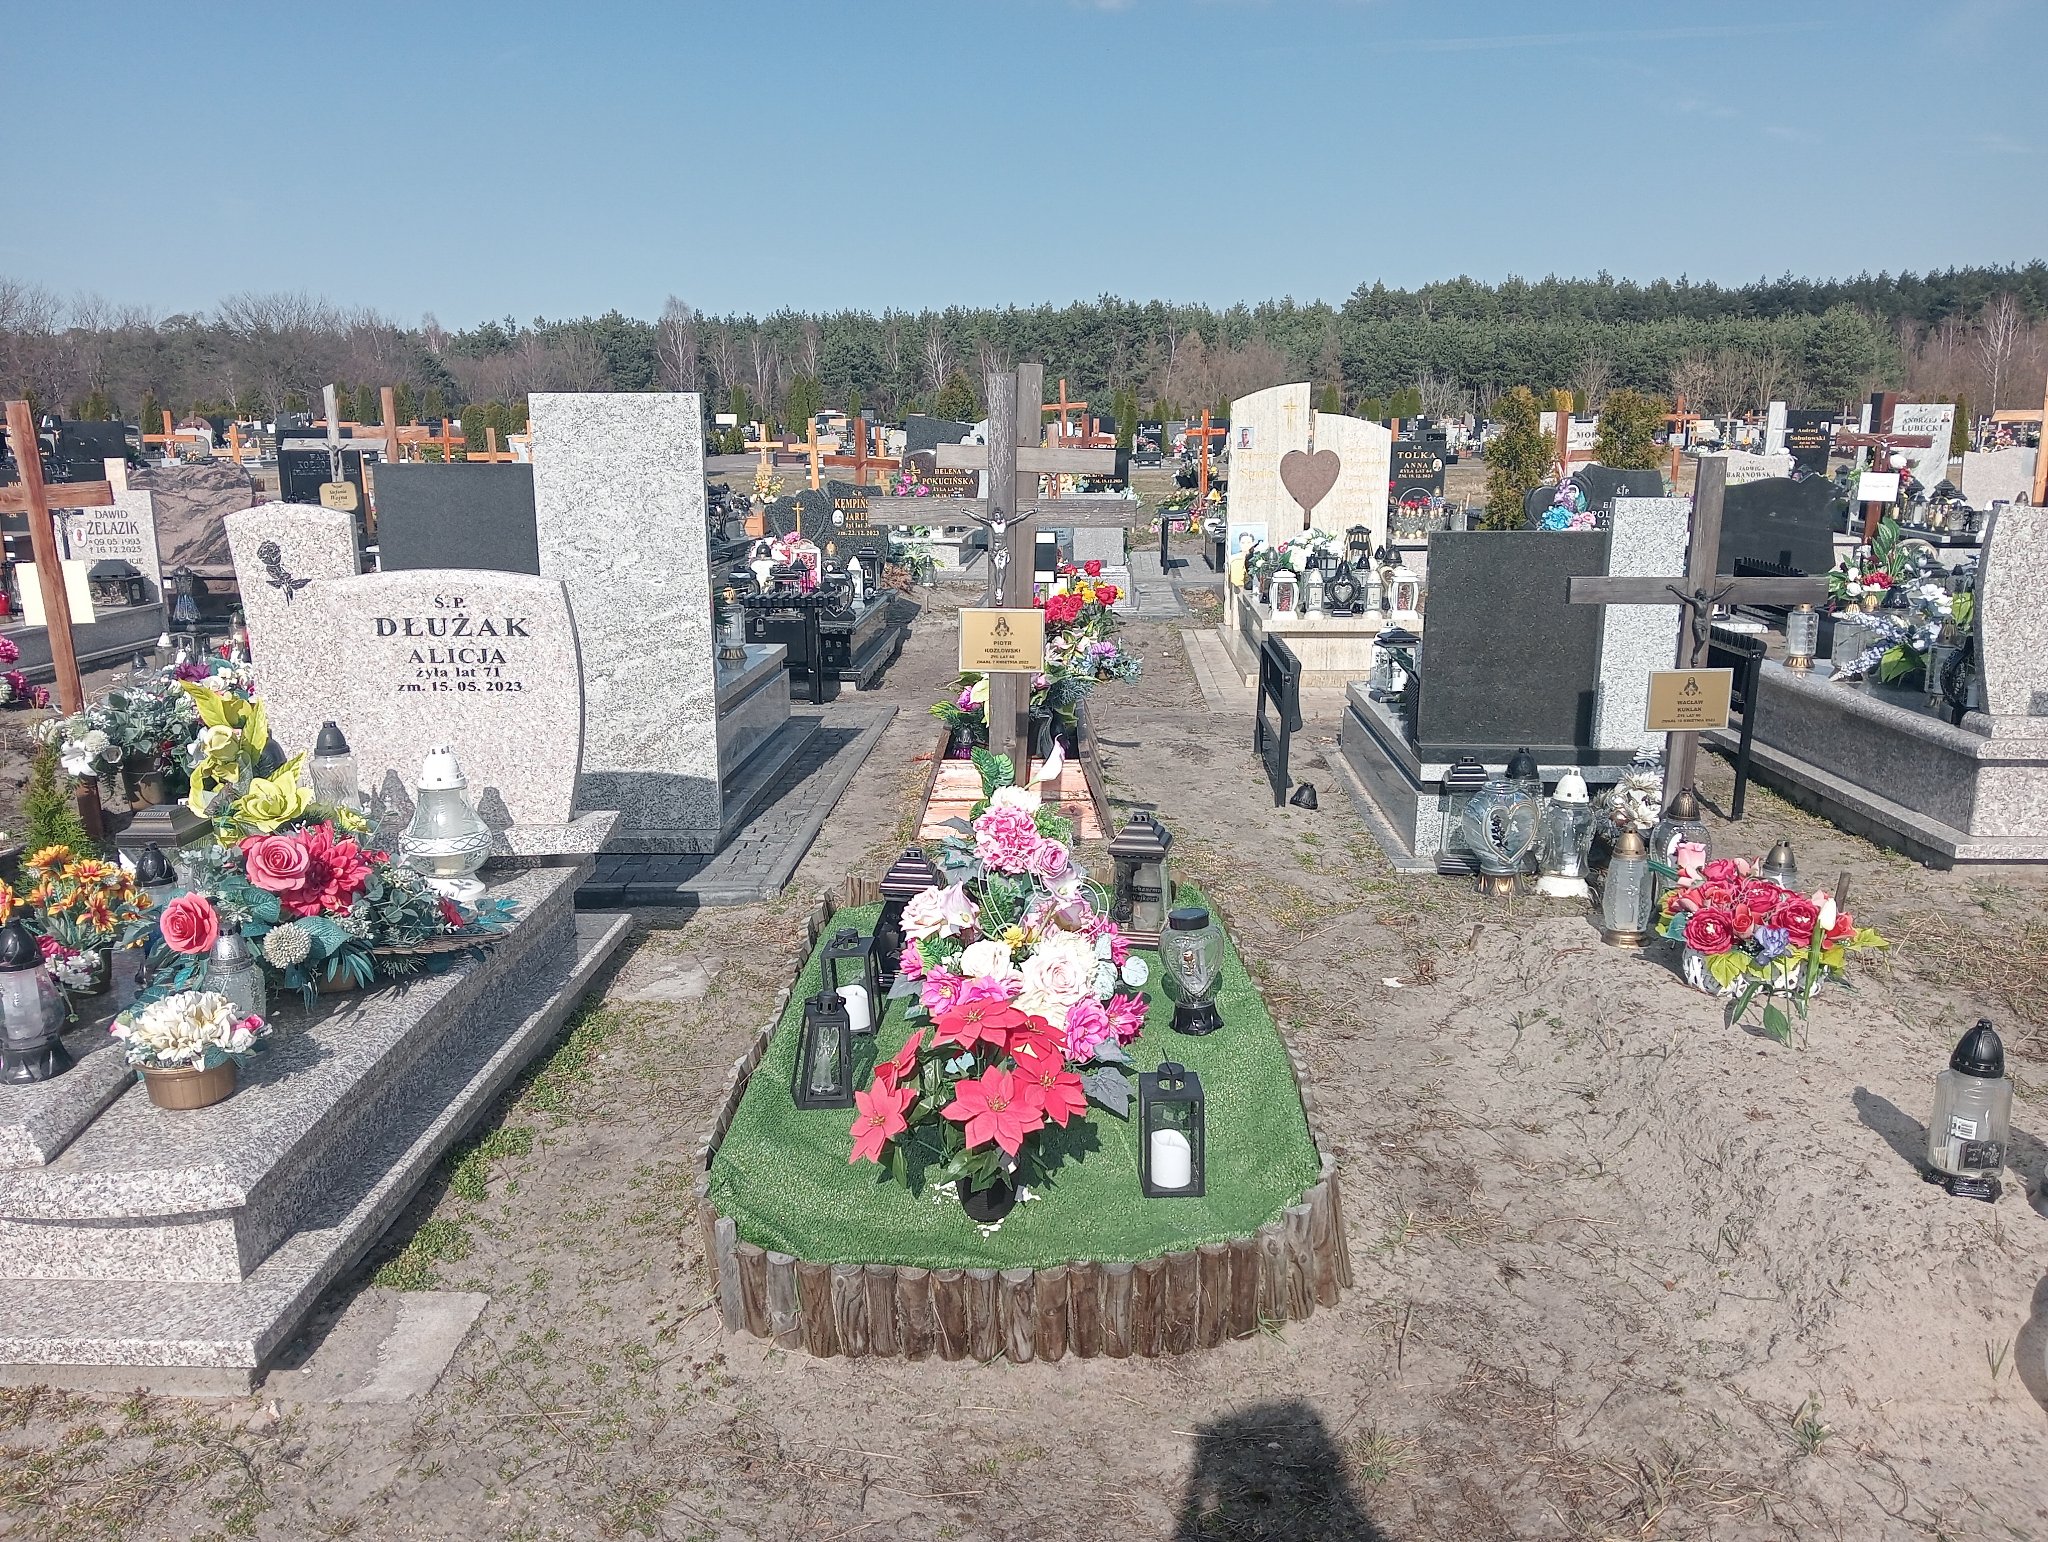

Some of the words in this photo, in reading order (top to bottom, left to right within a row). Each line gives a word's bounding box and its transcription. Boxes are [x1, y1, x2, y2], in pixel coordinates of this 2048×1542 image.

[1397, 451, 1438, 459] TOLKA
[922, 476, 974, 485] POKUCIŃSKA
[95, 510, 128, 519] DAWID
[86, 520, 140, 535] ŻELAZIK
[374, 613, 530, 637] DŁUŻAK
[408, 648, 507, 664] ALICJA
[416, 667, 448, 680] żyła
[455, 667, 476, 678] lat
[483, 667, 500, 678] 71
[397, 682, 426, 692] zm.
[485, 681, 522, 692] 2023
